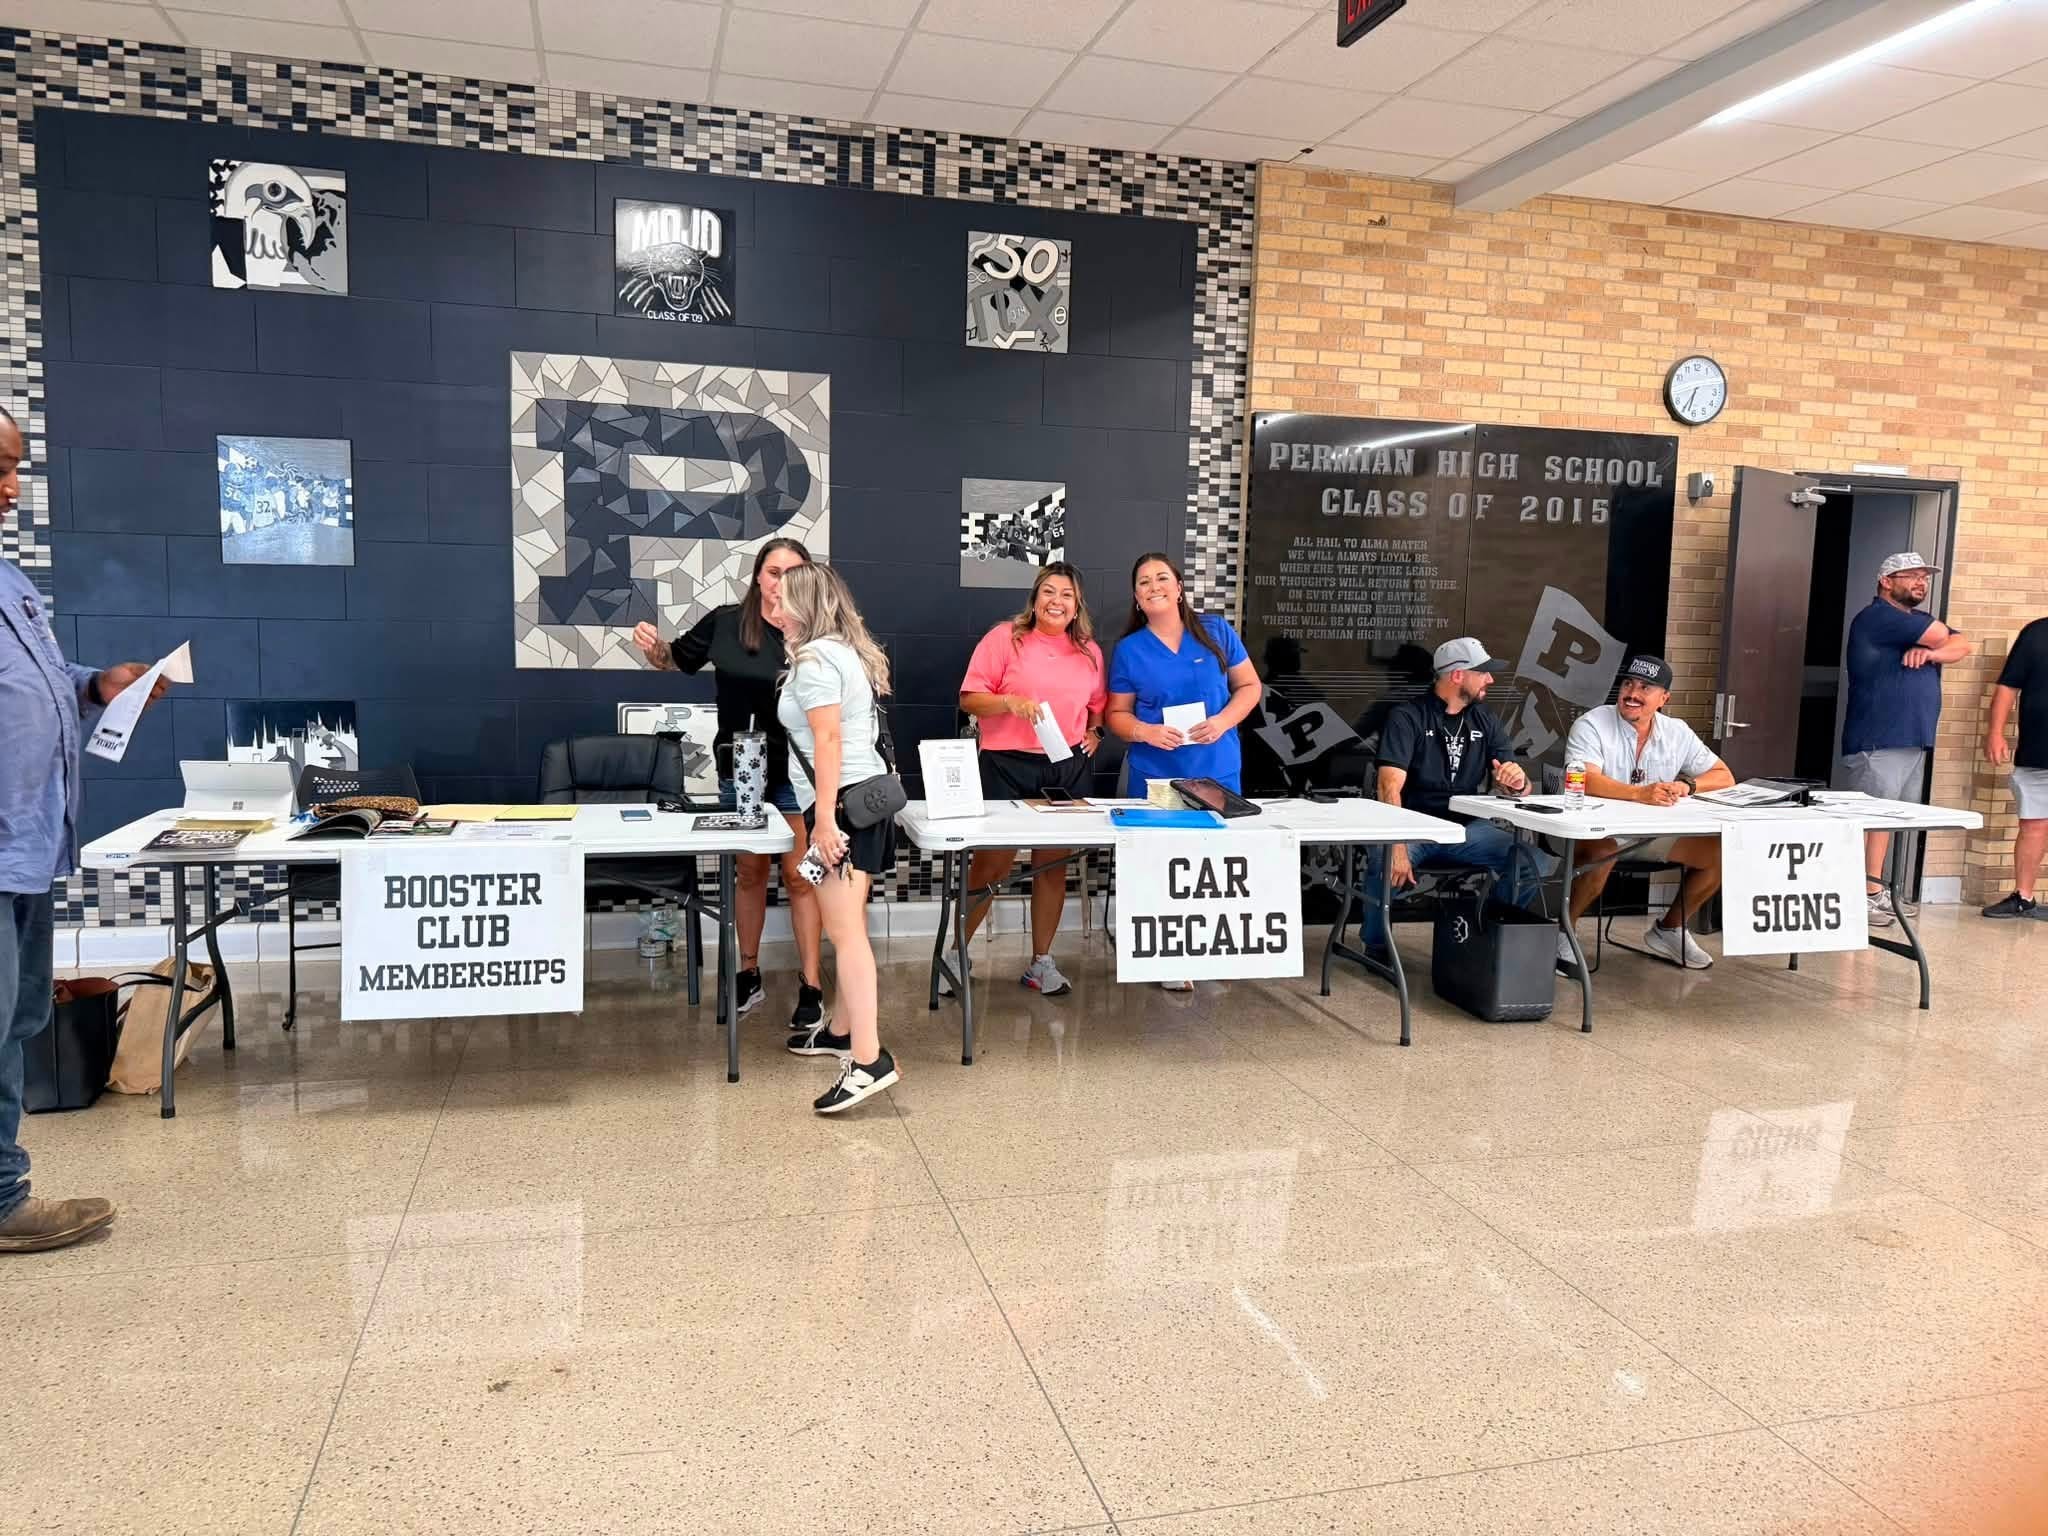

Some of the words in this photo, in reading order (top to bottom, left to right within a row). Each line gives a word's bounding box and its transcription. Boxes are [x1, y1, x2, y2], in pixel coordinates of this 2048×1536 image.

[632, 208, 722, 259] MOJO
[983, 234, 1060, 284] 50
[648, 310, 676, 321] CLASS
[678, 312, 690, 322] OF
[1268, 442, 1416, 476] PERMIAN
[1437, 450, 1519, 480] HIGH
[1544, 456, 1663, 488] SCHOOL
[1321, 487, 1428, 518] CLASS
[1449, 492, 1494, 521] OF
[1520, 496, 1610, 524] 2015
[1287, 550, 1305, 560] WE
[1307, 550, 1334, 561] WILL
[1337, 551, 1377, 562] ALWAYS
[1380, 552, 1412, 563] LOYAL
[1293, 536, 1314, 547] ALL
[1316, 537, 1341, 548] HAIL
[1344, 538, 1358, 549] TO
[1360, 539, 1389, 549] ALMA
[1255, 576, 1277, 586] OUR
[1280, 576, 1337, 587] THOUGHTS
[1339, 577, 1365, 588] WILL
[1368, 578, 1410, 589] RETURN
[1414, 579, 1427, 589] TO
[1337, 564, 1359, 575] THE
[1362, 565, 1403, 576] FUTURE
[1405, 566, 1439, 577] LEADS
[1276, 602, 1304, 612] WILL
[1306, 602, 1328, 613] OUR
[1330, 603, 1373, 614] BANNER
[1375, 604, 1401, 614] EVER
[1338, 590, 1368, 600] FIELD
[1370, 591, 1385, 601] OF
[1262, 615, 1298, 625] THERE
[1301, 615, 1328, 626] WILL
[1330, 616, 1345, 626] BE
[1347, 617, 1354, 626] A
[1356, 617, 1408, 627] GLORIOUS
[1282, 628, 1304, 639] FOR
[1306, 629, 1354, 640] PERMIAN
[1357, 629, 1382, 640] HIGH
[384, 872, 543, 909] BOOSTER
[1168, 856, 1250, 900] CAR
[1752, 892, 1841, 933] SIGNS
[417, 914, 511, 950] CLUB
[1131, 912, 1288, 959] DECALS
[359, 958, 567, 992] MEMBERSHIPS
